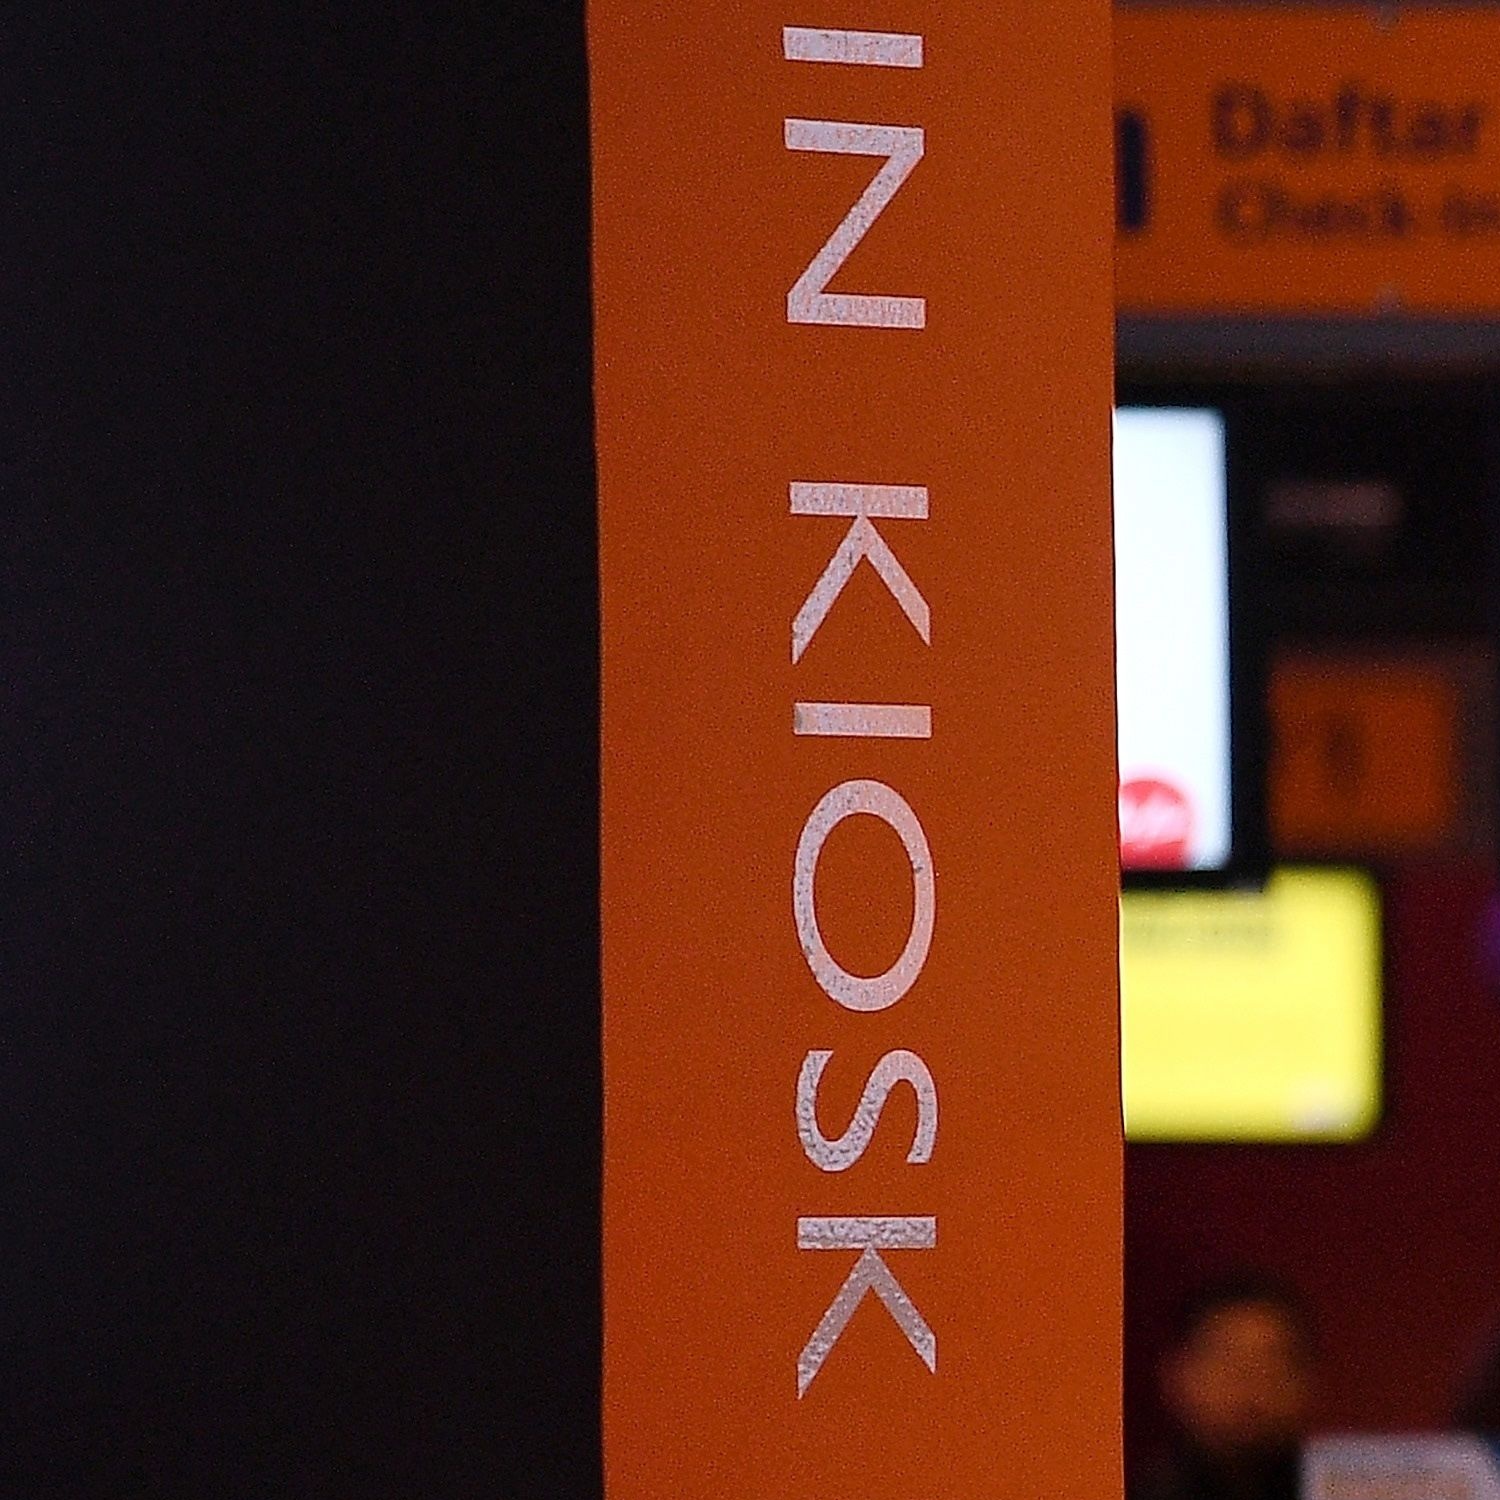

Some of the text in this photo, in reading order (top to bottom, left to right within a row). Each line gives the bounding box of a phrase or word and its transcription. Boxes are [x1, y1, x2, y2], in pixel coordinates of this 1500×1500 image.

[1211, 81, 1481, 159] Daftar
[783, 25, 939, 1400] IN KIOSK
